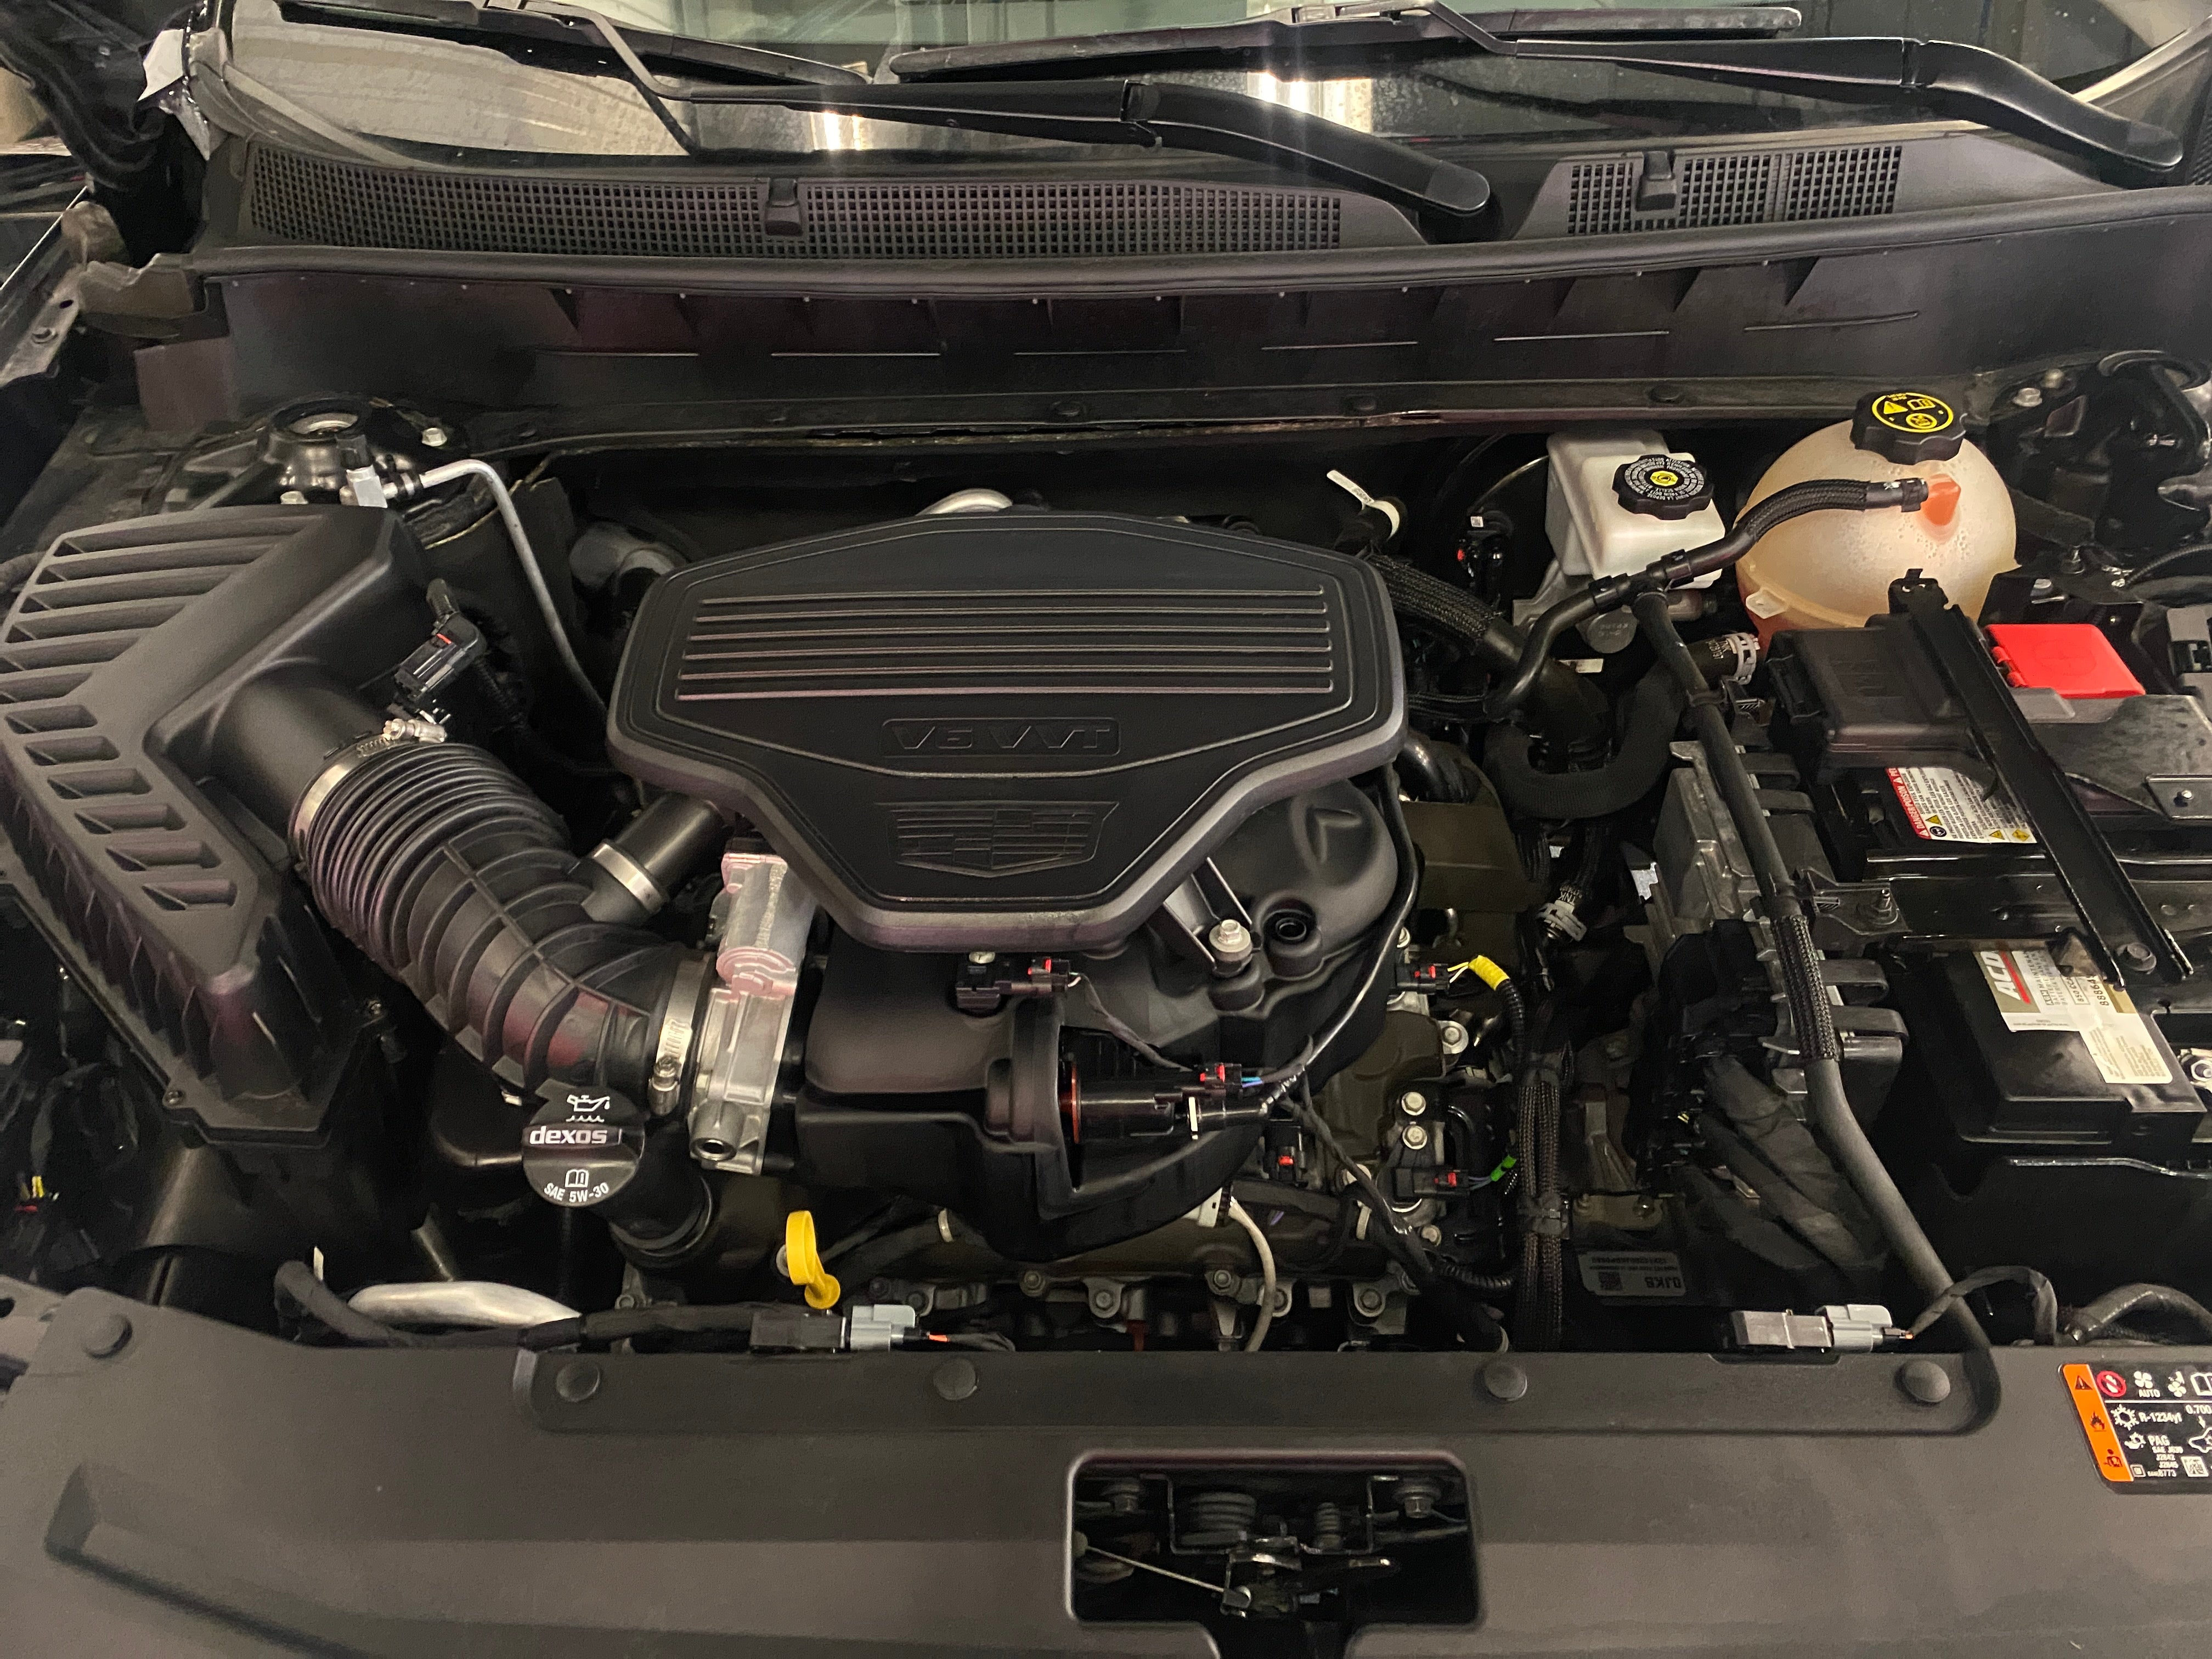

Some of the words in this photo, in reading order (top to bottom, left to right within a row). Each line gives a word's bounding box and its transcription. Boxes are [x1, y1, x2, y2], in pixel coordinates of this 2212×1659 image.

[891, 726, 973, 749] V6
[990, 725, 1110, 748] VVT
[1897, 786, 1914, 806] POISON
[1907, 807, 1926, 829] DANGER
[1558, 891, 1575, 906] TNK
[1980, 951, 2021, 1000] ACD
[529, 1126, 607, 1144] dexos
[544, 1182, 566, 1201] SAE
[569, 1182, 610, 1203] 5W-30
[2138, 1389, 2160, 1398] AUTO
[2138, 1412, 2182, 1424] R-1234yf
[2185, 1404, 2212, 1414] 0.700
[2147, 1435, 2170, 1446] PAG
